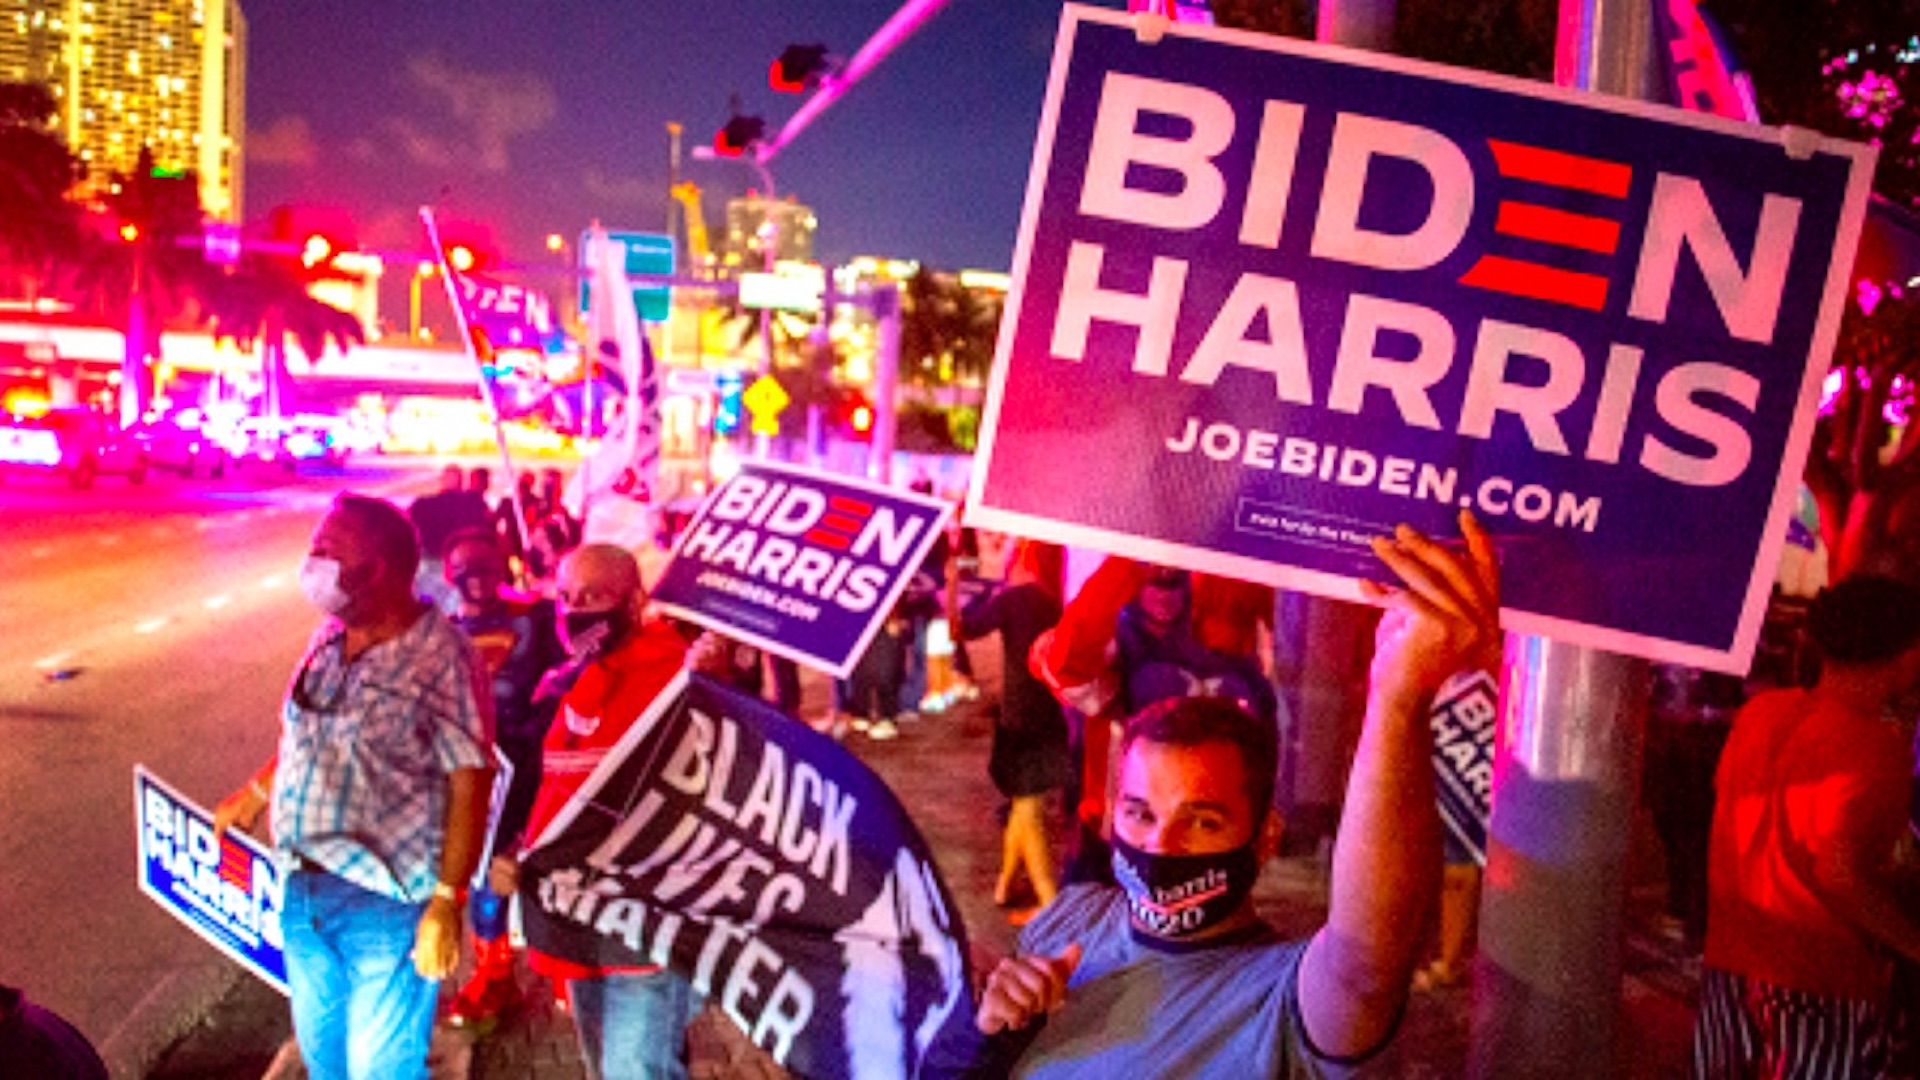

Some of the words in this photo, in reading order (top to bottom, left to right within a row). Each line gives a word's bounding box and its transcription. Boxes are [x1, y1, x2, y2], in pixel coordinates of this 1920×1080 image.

[1080, 71, 1802, 345] BIDEN
[1048, 240, 1762, 487] HARRIS
[713, 475, 924, 566] BIDEN
[1165, 417, 1602, 533] JOEBIDEN.COM
[683, 522, 889, 612] HARRIS
[146, 788, 284, 914] BIDEN
[662, 709, 857, 894] BLACK
[539, 868, 815, 1065] MATTER
